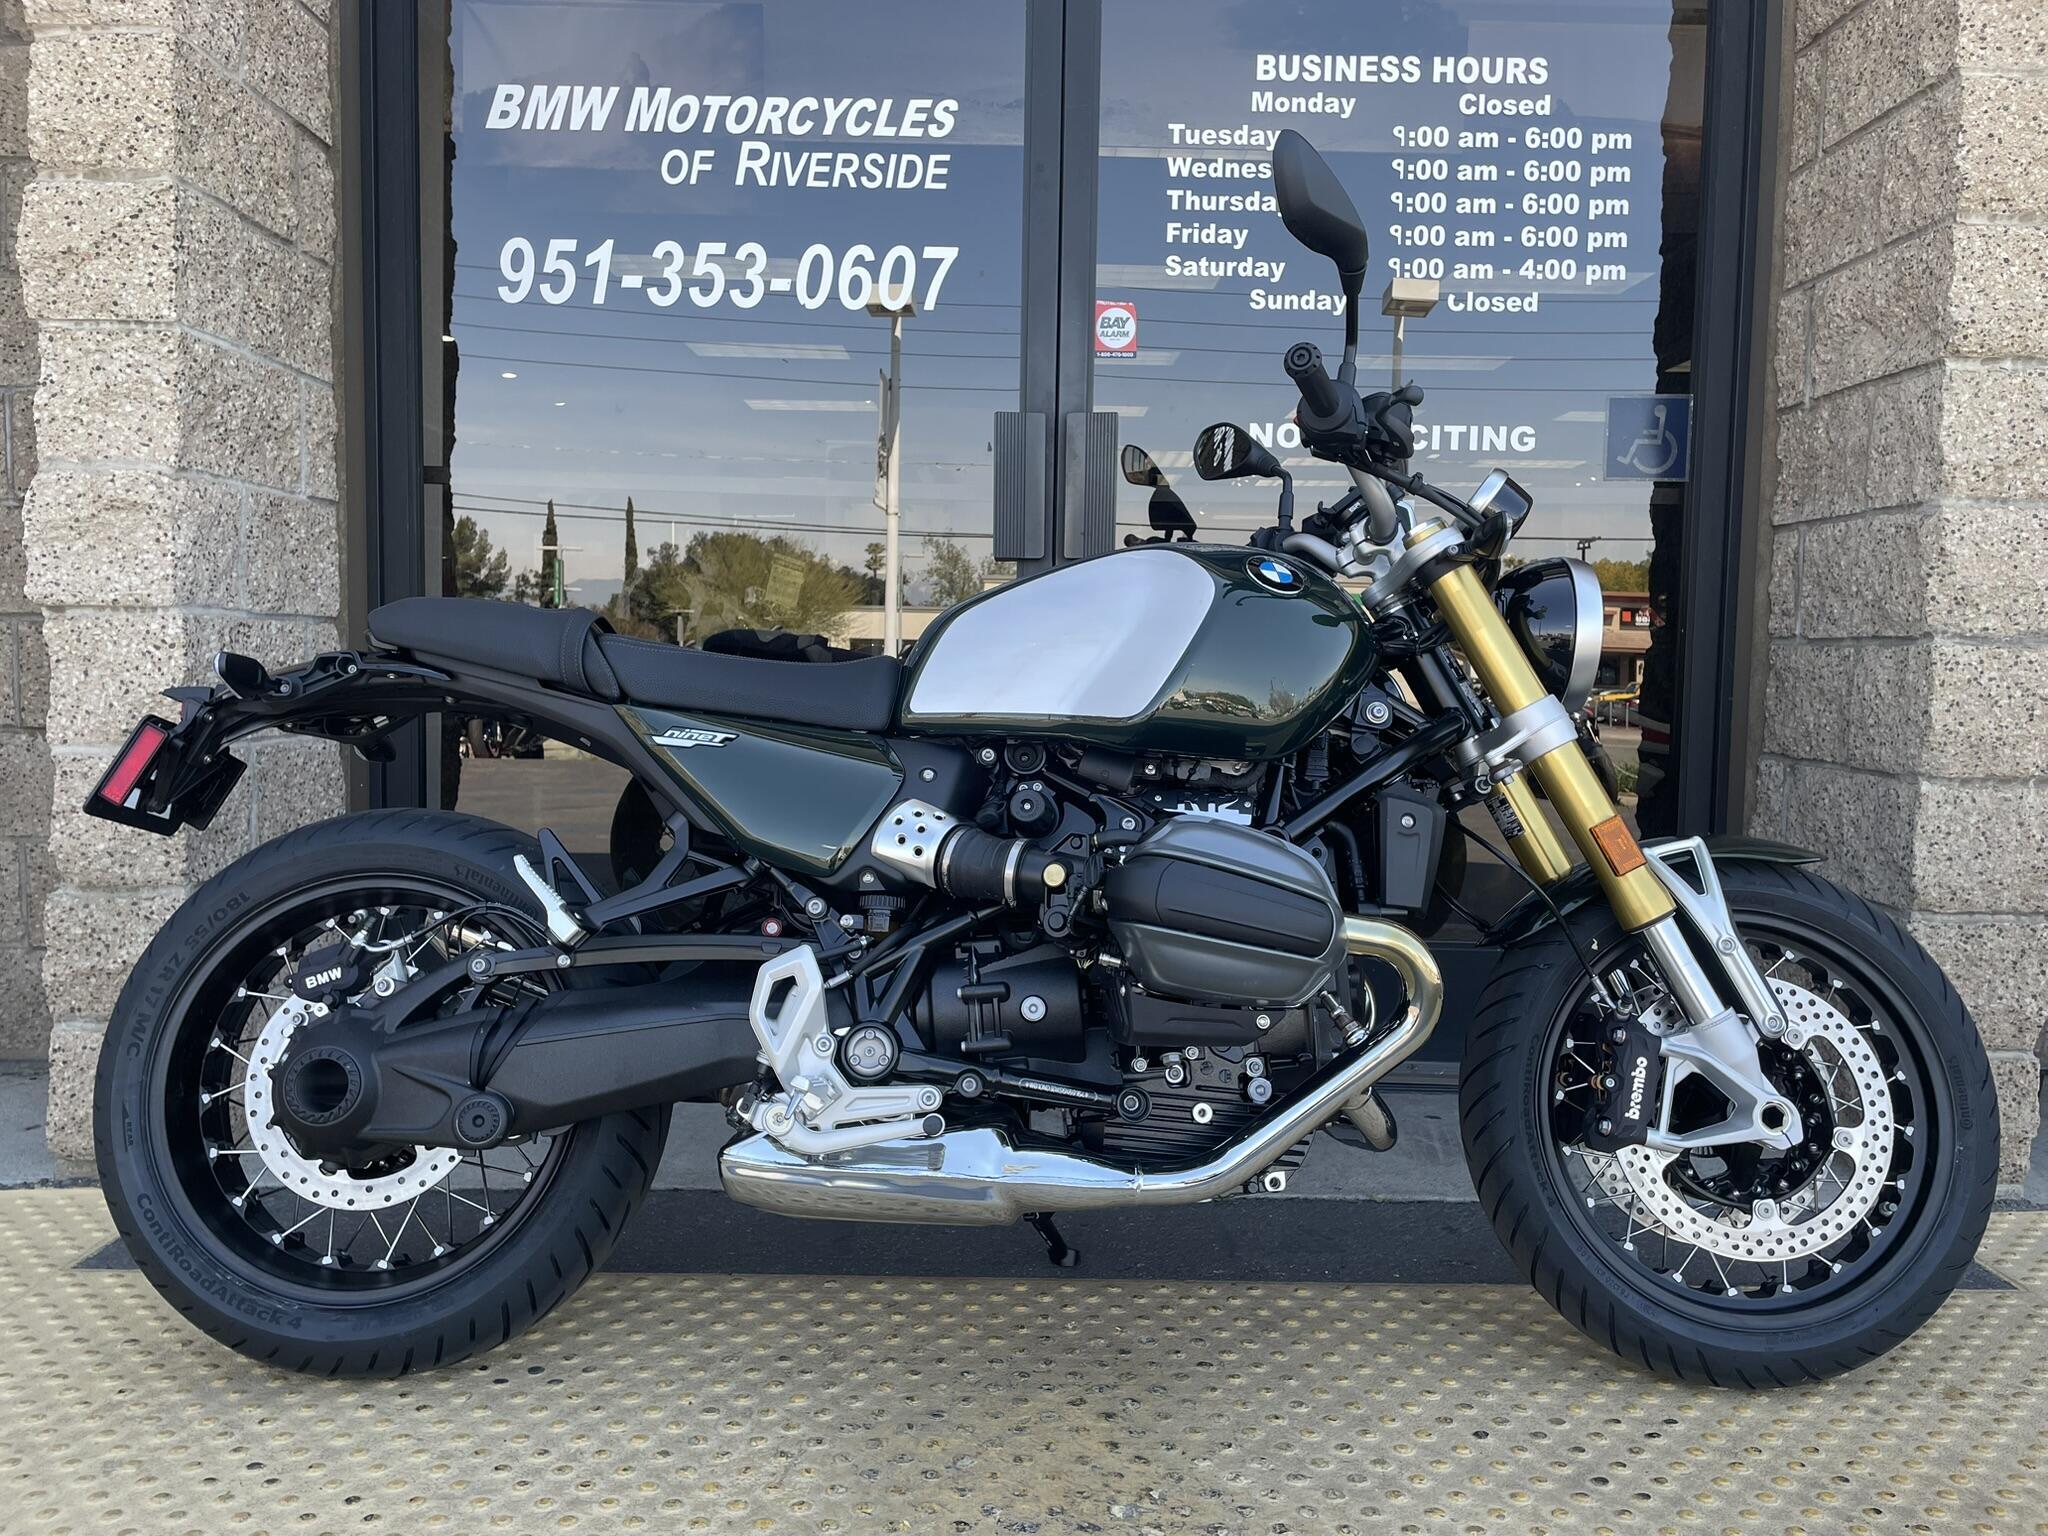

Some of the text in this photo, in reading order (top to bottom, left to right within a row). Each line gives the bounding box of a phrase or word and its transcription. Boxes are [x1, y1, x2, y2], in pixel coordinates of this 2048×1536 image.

[1256, 54, 1549, 85] BUSINESS HOURS
[485, 83, 959, 138] BMW MOTORCYCLES
[1251, 91, 1551, 119] Monday Closed
[1167, 123, 1282, 152] Tuesday
[1392, 125, 1450, 148] 9:00
[1458, 131, 1499, 148] am
[1524, 126, 1583, 149] 6:00
[1591, 133, 1632, 155] pm
[661, 140, 951, 190] OF RIVERSIDE
[1166, 156, 1272, 179] Wednes
[1391, 158, 1449, 181] 9:00
[1456, 164, 1498, 181] am
[1523, 159, 1582, 182] 6:00
[1590, 166, 1631, 188] pm
[1166, 189, 1282, 217] Thursda
[1390, 191, 1447, 214] 9:00
[1455, 197, 1496, 214] am
[1522, 192, 1580, 215] 6:00
[1588, 199, 1629, 220] pm
[1166, 222, 1249, 250] Friday
[1389, 224, 1446, 247] 9:00
[1454, 230, 1495, 247] am
[1521, 225, 1579, 248] 6:00
[1587, 231, 1628, 253] pm
[497, 237, 960, 311] 951-353-0607
[1164, 255, 1286, 283] Saturday
[1388, 257, 1444, 279] 9:00
[1453, 263, 1494, 280] am
[1518, 258, 1577, 281] 4:00
[1585, 264, 1626, 286] pm
[1249, 288, 1539, 316] Sunday Closed
[1100, 316, 1131, 329] BAY
[1100, 330, 1130, 338] ALARM
[1248, 422, 1301, 449] NO
[1411, 424, 1536, 452] CITING
[184, 891, 251, 951] 180/55
[157, 951, 186, 983] ZR
[305, 966, 342, 989] BMW
[144, 985, 165, 1009] 17
[1624, 1056, 1648, 1120] brembo
[136, 1192, 283, 1326] ContiRoadAttack
[286, 1316, 304, 1330] 4
